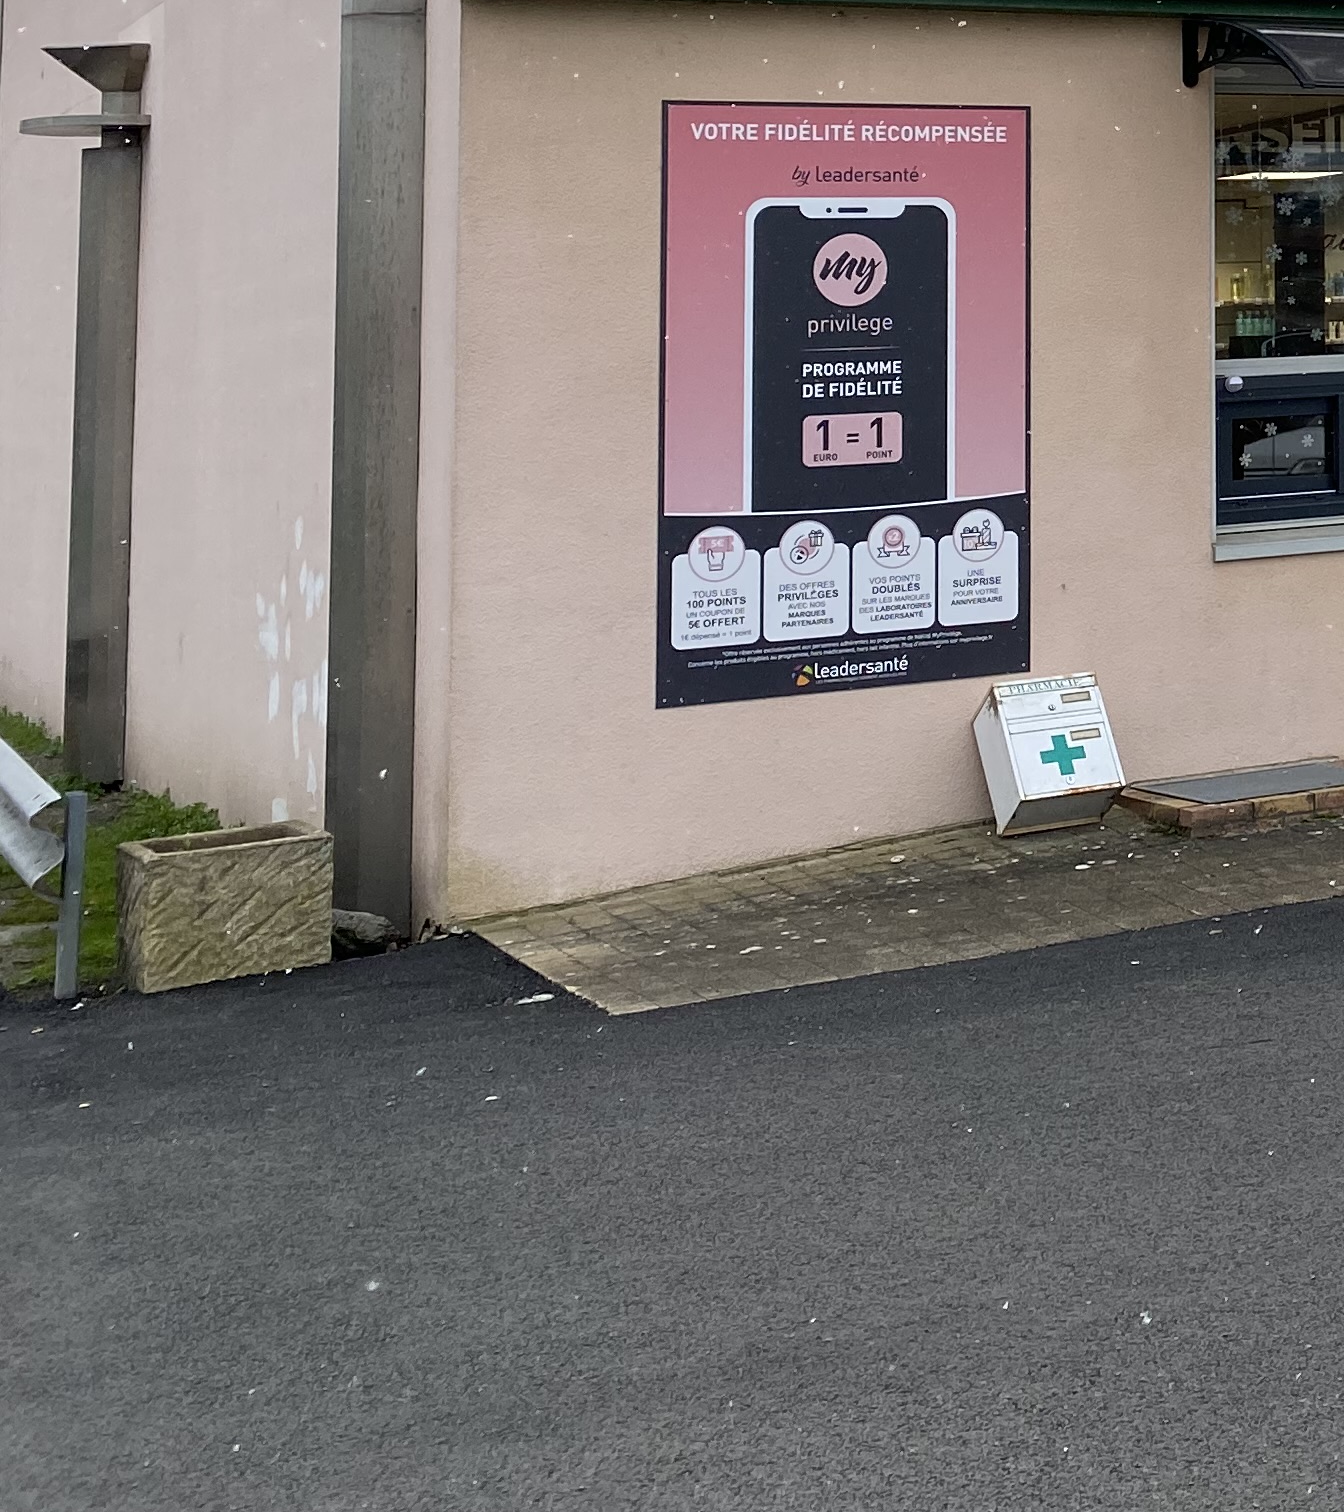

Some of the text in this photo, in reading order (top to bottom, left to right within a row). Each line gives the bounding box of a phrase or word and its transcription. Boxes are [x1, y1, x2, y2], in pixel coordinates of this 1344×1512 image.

[690, 120, 1008, 144] VOTRE FIDÉLITÉ RÉCOMPENSÉE
[791, 166, 810, 187] by
[807, 313, 894, 338] privilege
[802, 360, 903, 379] PROGRAMME
[802, 377, 903, 399] DE FIDÉLITÉ
[815, 419, 830, 452] 1
[869, 417, 884, 448] 1
[812, 449, 893, 463] EURO POINT
[966, 568, 985, 577] UNE
[868, 574, 921, 585] VOS POINTS
[952, 576, 1002, 588] SURPRISE
[778, 580, 835, 592] DES OFFRES
[871, 583, 921, 595] DOUBLÉS
[952, 587, 999, 597] POUR VOTRE
[692, 588, 738, 598] TOUS LES
[861, 593, 931, 605] SUR LES MARQUES
[686, 596, 747, 609] 100 POINTS
[787, 602, 808, 610] AVEC
[950, 595, 1003, 606] ANNIVERSAIRE
[686, 607, 746, 619] UN COUPON DE
[875, 601, 932, 613] LABORATOIRES
[788, 609, 826, 619] MARQUES
[870, 609, 924, 622] LEADERSANTÉ
[688, 616, 746, 630] 5€ OFFERT
[781, 617, 834, 629] PARTENAIRES
[1008, 677, 1083, 695] PHARMACIE
